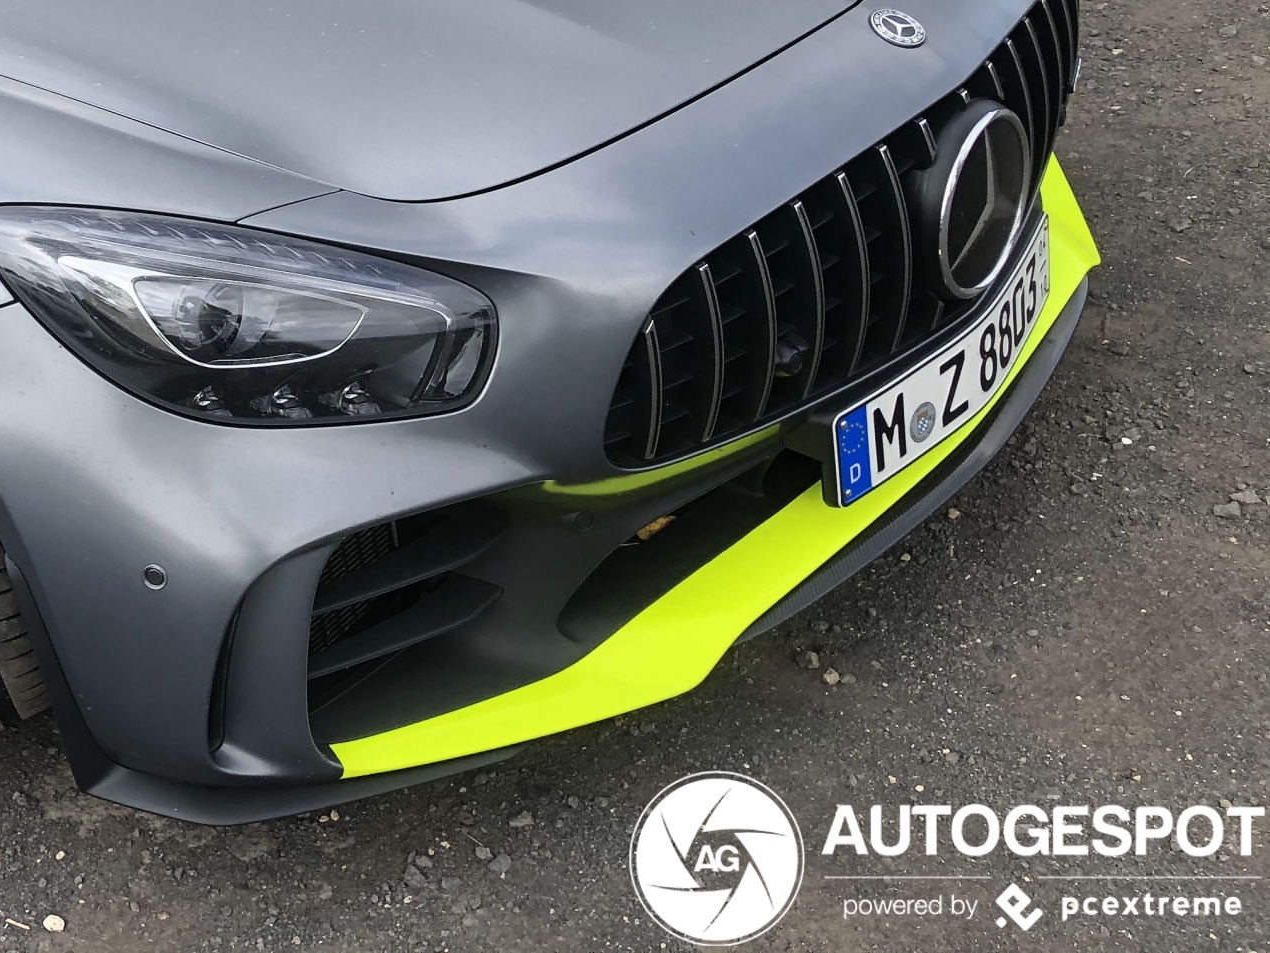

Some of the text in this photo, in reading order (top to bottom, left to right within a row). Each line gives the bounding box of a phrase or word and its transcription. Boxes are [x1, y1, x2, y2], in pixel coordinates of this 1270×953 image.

[873, 253, 1037, 473] M Z 8803
[849, 462, 861, 484] D
